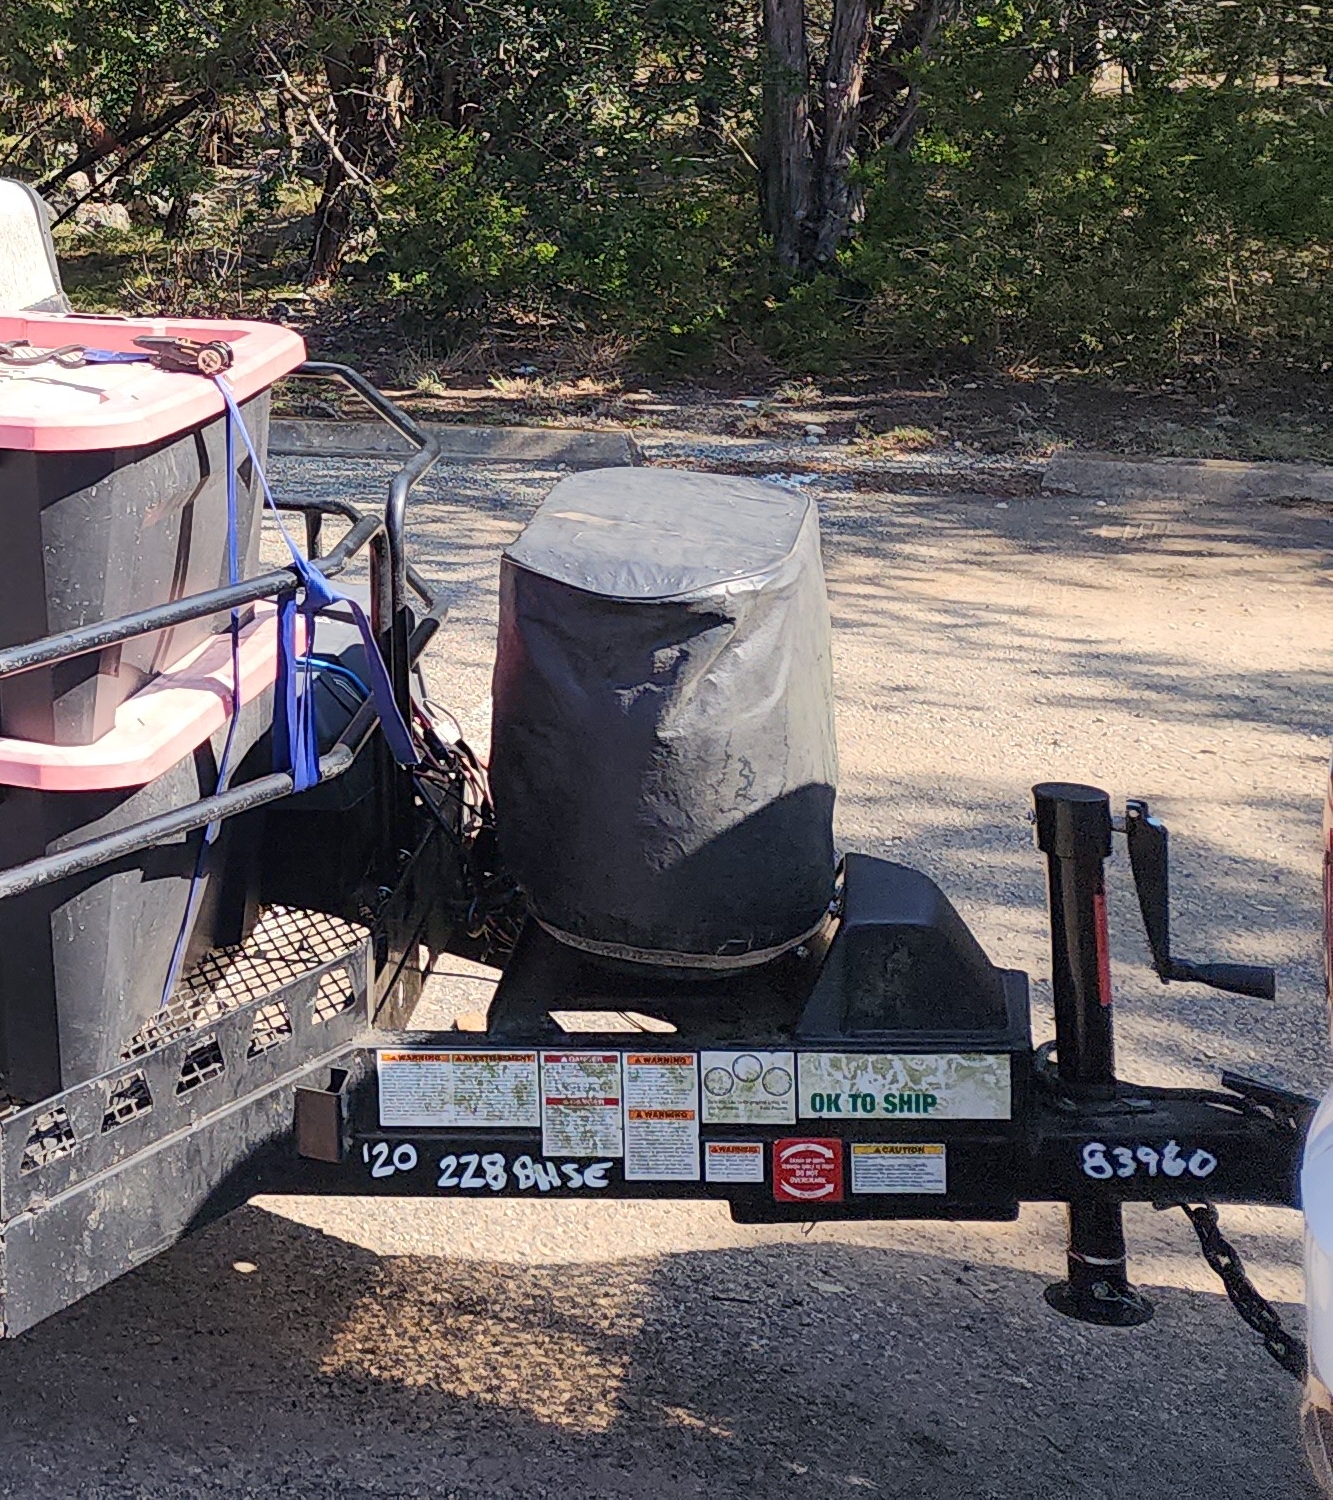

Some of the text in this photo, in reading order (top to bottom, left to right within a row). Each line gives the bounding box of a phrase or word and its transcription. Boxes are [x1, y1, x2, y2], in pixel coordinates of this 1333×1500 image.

[643, 1056, 687, 1064] WARNING
[810, 1093, 842, 1113] OK
[848, 1093, 876, 1113] TO
[883, 1093, 938, 1114] SHIP
[645, 1111, 688, 1119] WARNING
[882, 1145, 926, 1154] CAUTION
[363, 1142, 418, 1178] '20
